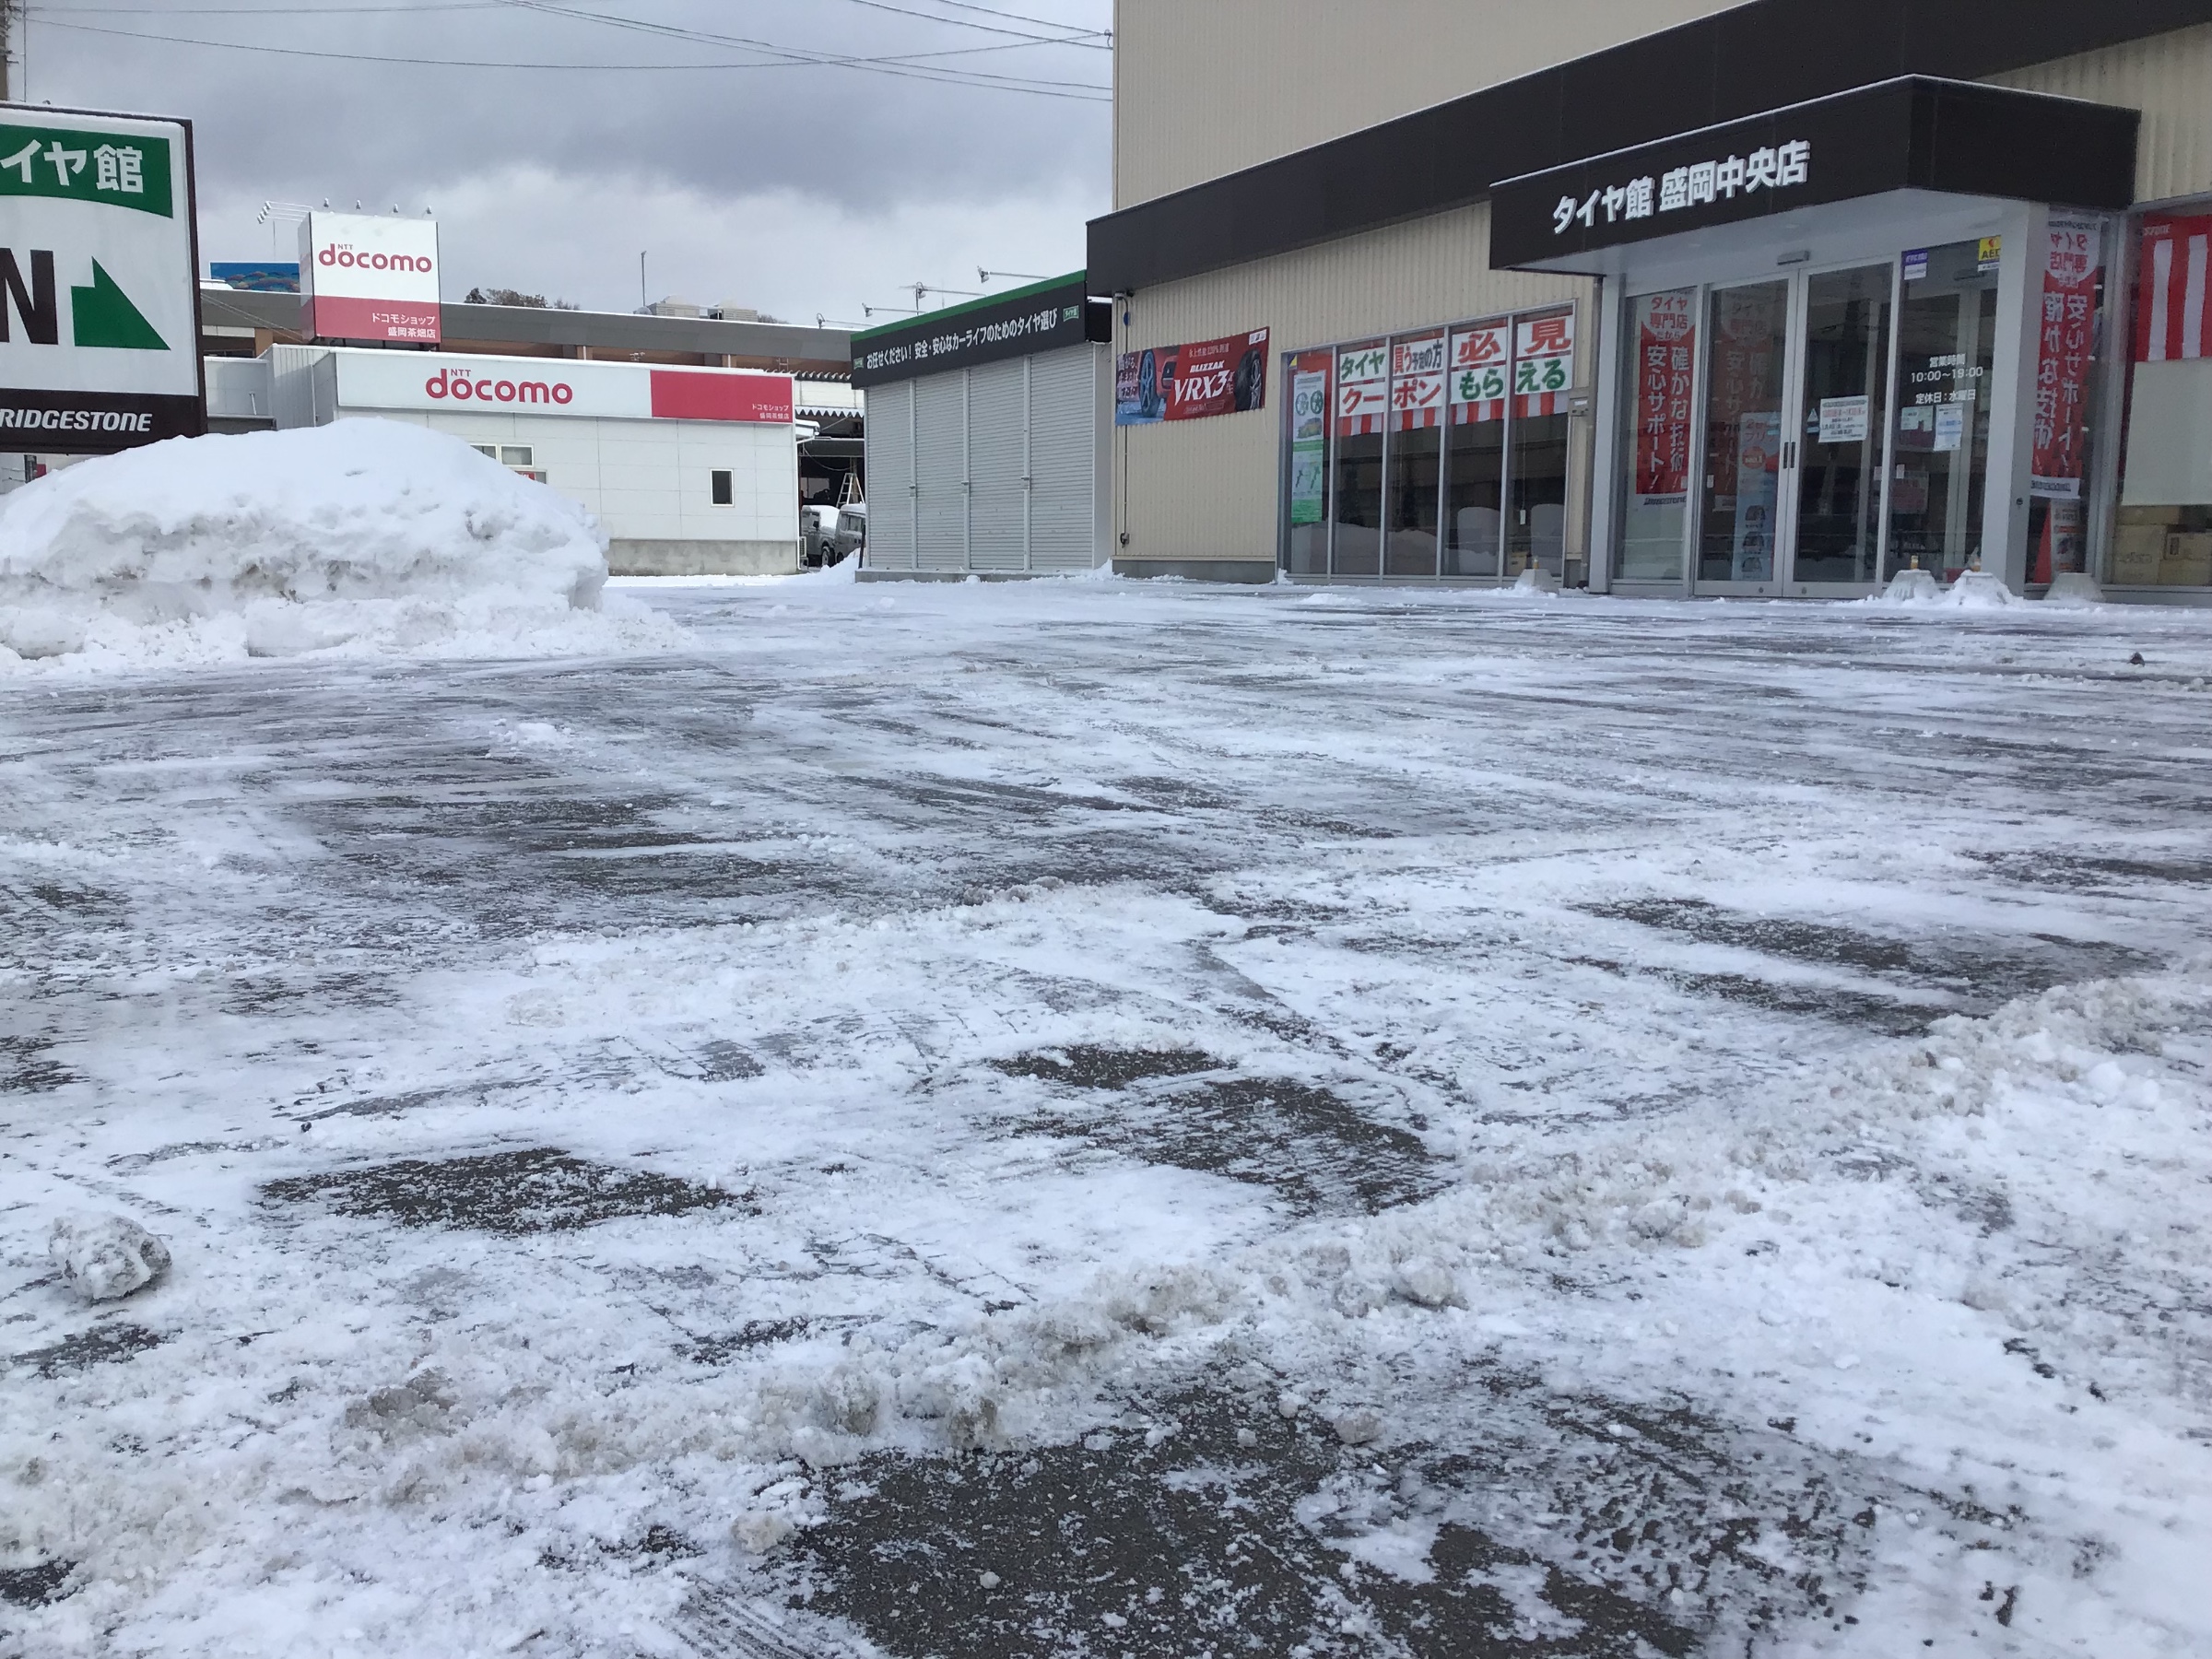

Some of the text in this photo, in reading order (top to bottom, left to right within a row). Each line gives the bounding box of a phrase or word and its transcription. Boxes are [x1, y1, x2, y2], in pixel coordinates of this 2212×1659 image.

[0, 139, 144, 194] イヤ館
[1553, 139, 1810, 234] タイヤ館 盛岡中央店
[319, 243, 432, 273] docomo
[372, 312, 436, 325] ドコモショップ
[1652, 296, 1688, 311] タイヤ
[388, 326, 436, 339] 盛岡茶畑店
[451, 369, 471, 377] NTT
[1190, 359, 1225, 373] BLIZZAK
[1341, 351, 1385, 381] タイヤ
[426, 368, 573, 404] docomo
[1174, 369, 1231, 406] VRX3
[1342, 358, 1566, 414] クーポン もらえる
